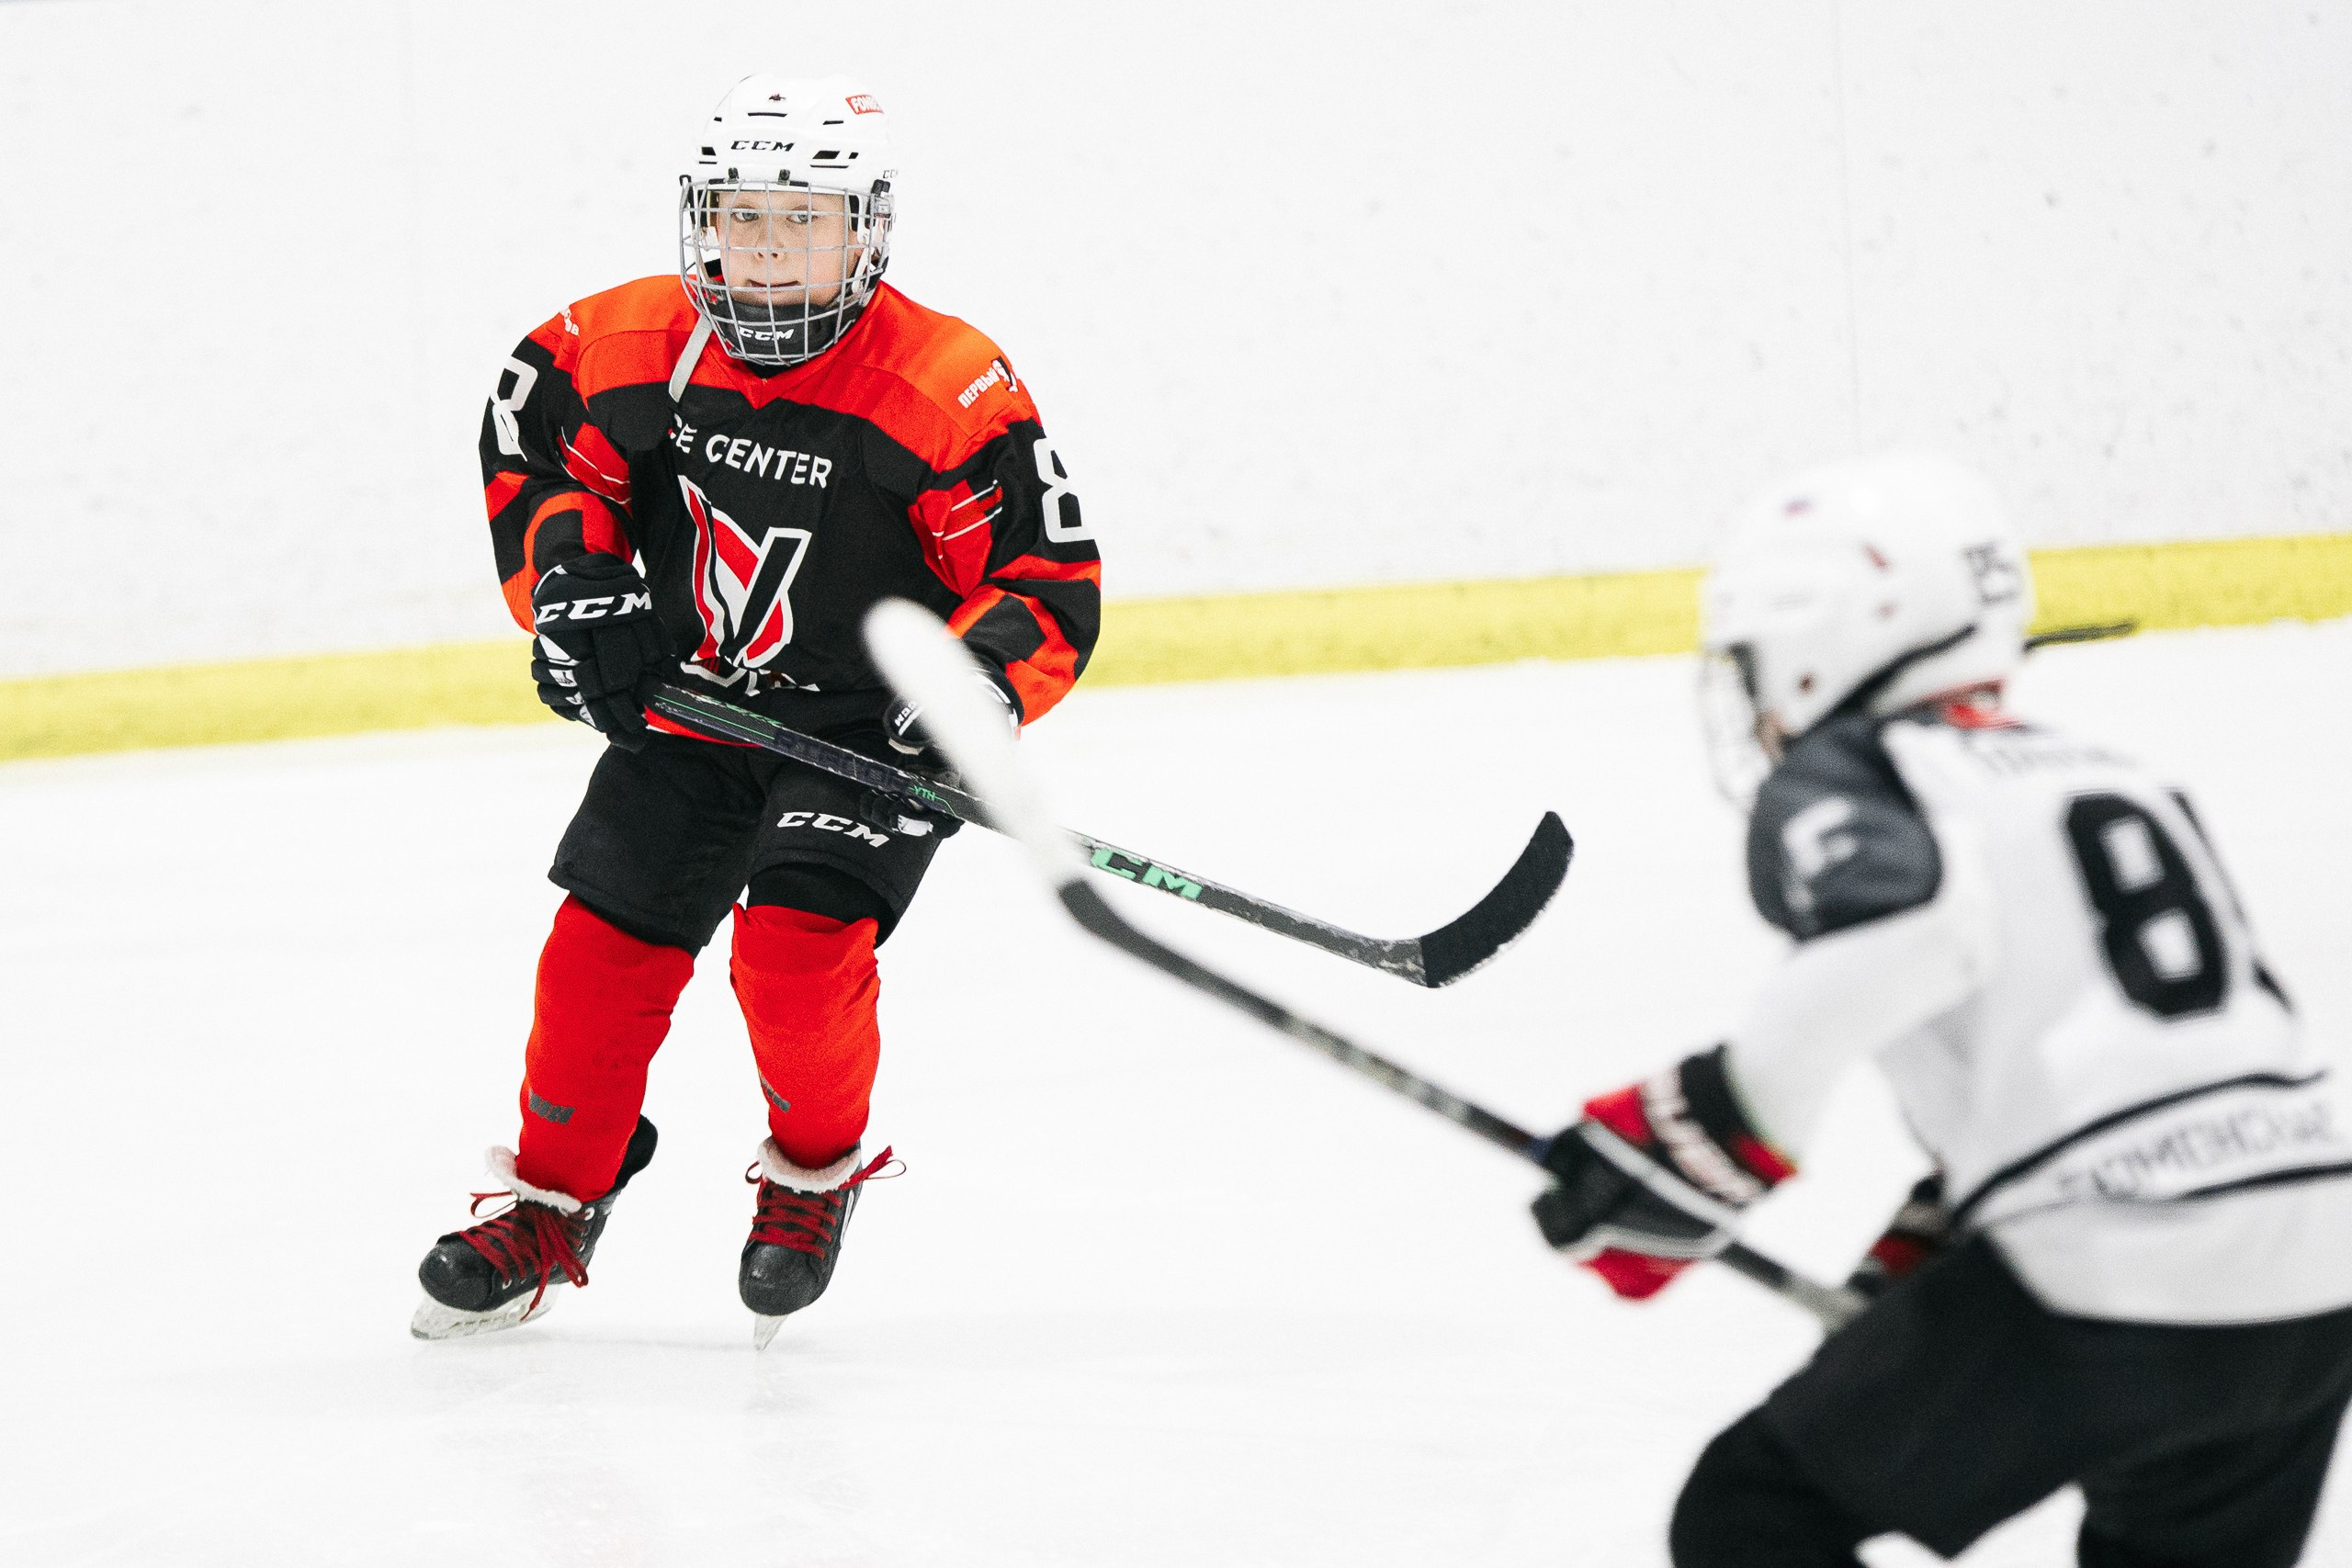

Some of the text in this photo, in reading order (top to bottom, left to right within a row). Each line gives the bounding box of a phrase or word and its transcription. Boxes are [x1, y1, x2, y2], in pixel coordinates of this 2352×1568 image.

[730, 140, 795, 152] CCM
[739, 326, 795, 341] CCM
[706, 434, 832, 489] CENTER
[535, 592, 652, 625] CCM
[777, 812, 890, 848] CCM
[1090, 848, 1203, 900] CM
[2061, 786, 2299, 1021] 8
